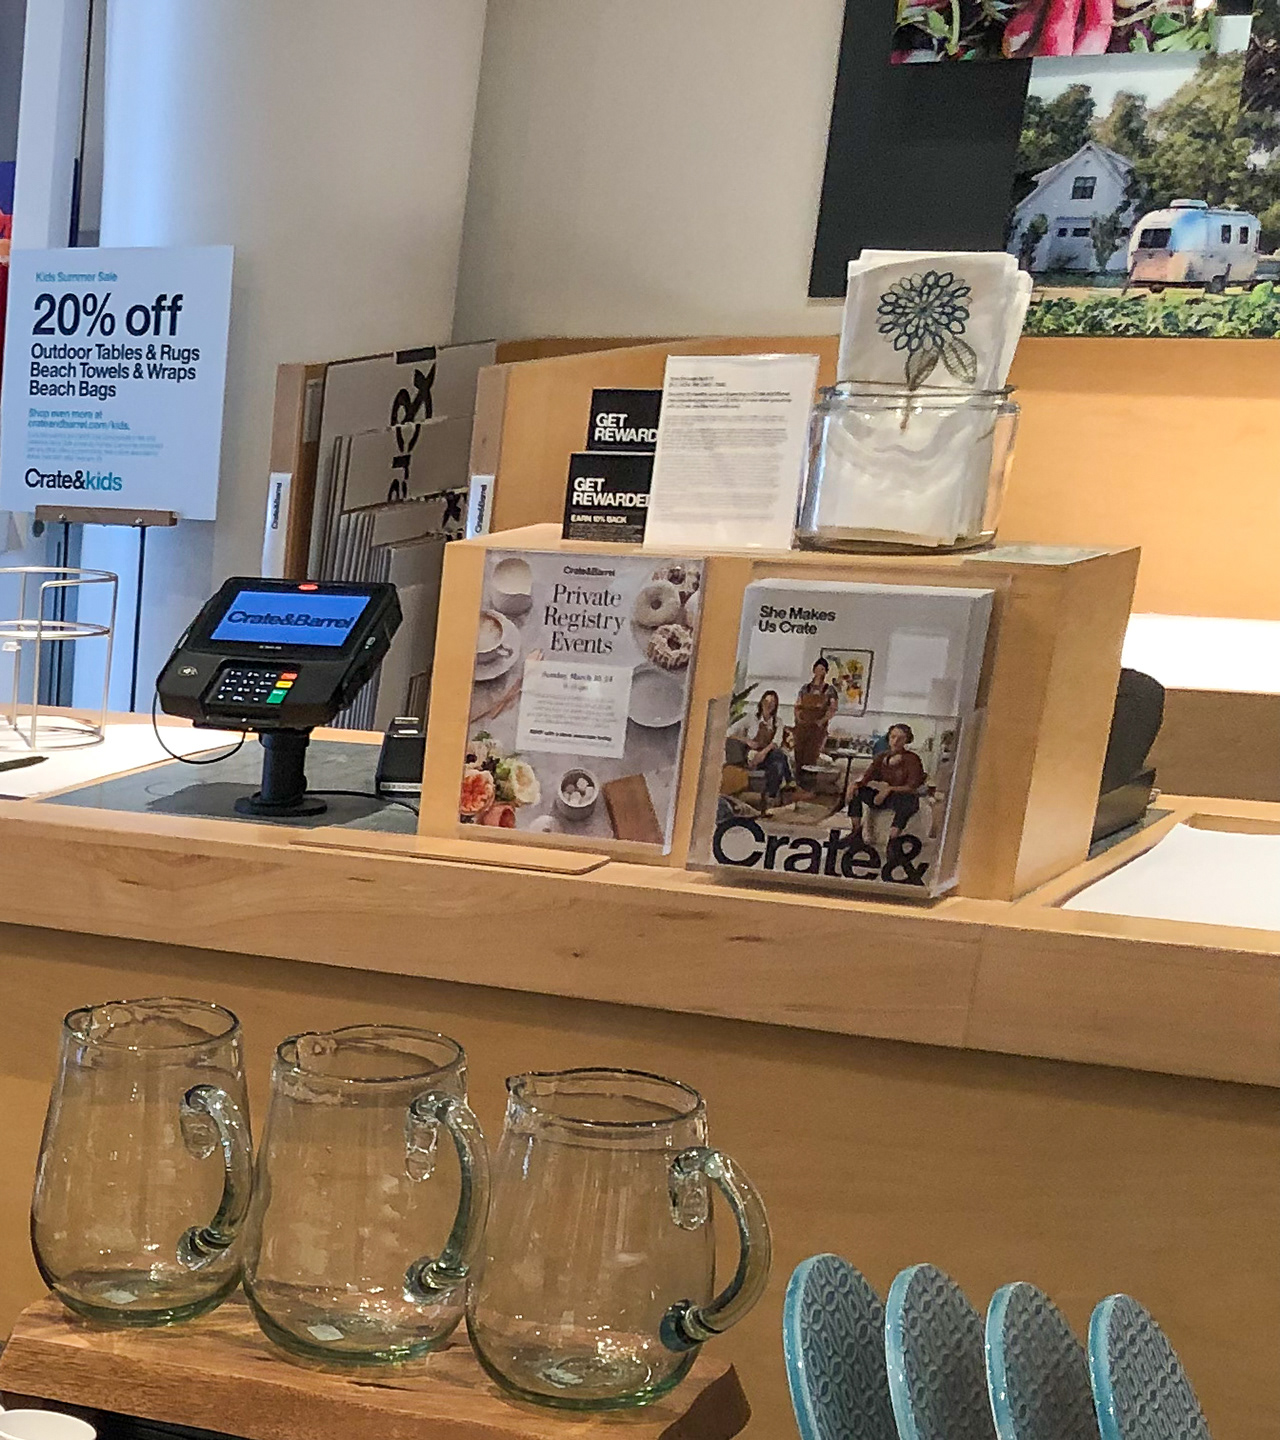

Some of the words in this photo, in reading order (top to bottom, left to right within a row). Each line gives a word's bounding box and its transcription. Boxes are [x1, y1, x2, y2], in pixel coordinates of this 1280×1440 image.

[35, 272, 56, 282] Kids
[57, 272, 96, 282] Summer
[98, 272, 118, 282] Sale
[32, 292, 116, 337] 20%
[125, 294, 184, 336] off
[31, 343, 92, 359] Outdoor
[95, 343, 142, 360] Tables
[146, 344, 156, 361] &
[160, 344, 200, 364] Rugs
[30, 362, 76, 378] Beach
[80, 363, 129, 379] Towels
[133, 363, 143, 379] &
[147, 363, 196, 383] Wraps
[29, 380, 75, 396] Beach
[79, 381, 116, 401] Bags
[596, 413, 628, 428] GET
[594, 428, 658, 443] REWARD
[25, 468, 123, 491] Crate&kids
[574, 477, 606, 492] GET
[572, 492, 650, 507] REWARDE
[563, 566, 615, 576] Crate&Barrel
[553, 583, 621, 607] Private
[227, 611, 355, 629] Crate&Barrel
[544, 605, 625, 636] Registry
[760, 606, 786, 619] She
[790, 607, 836, 621] Makes
[758, 620, 776, 633] Us
[779, 621, 817, 634] Crate
[551, 631, 613, 654] Events
[713, 818, 930, 887] Crate&
